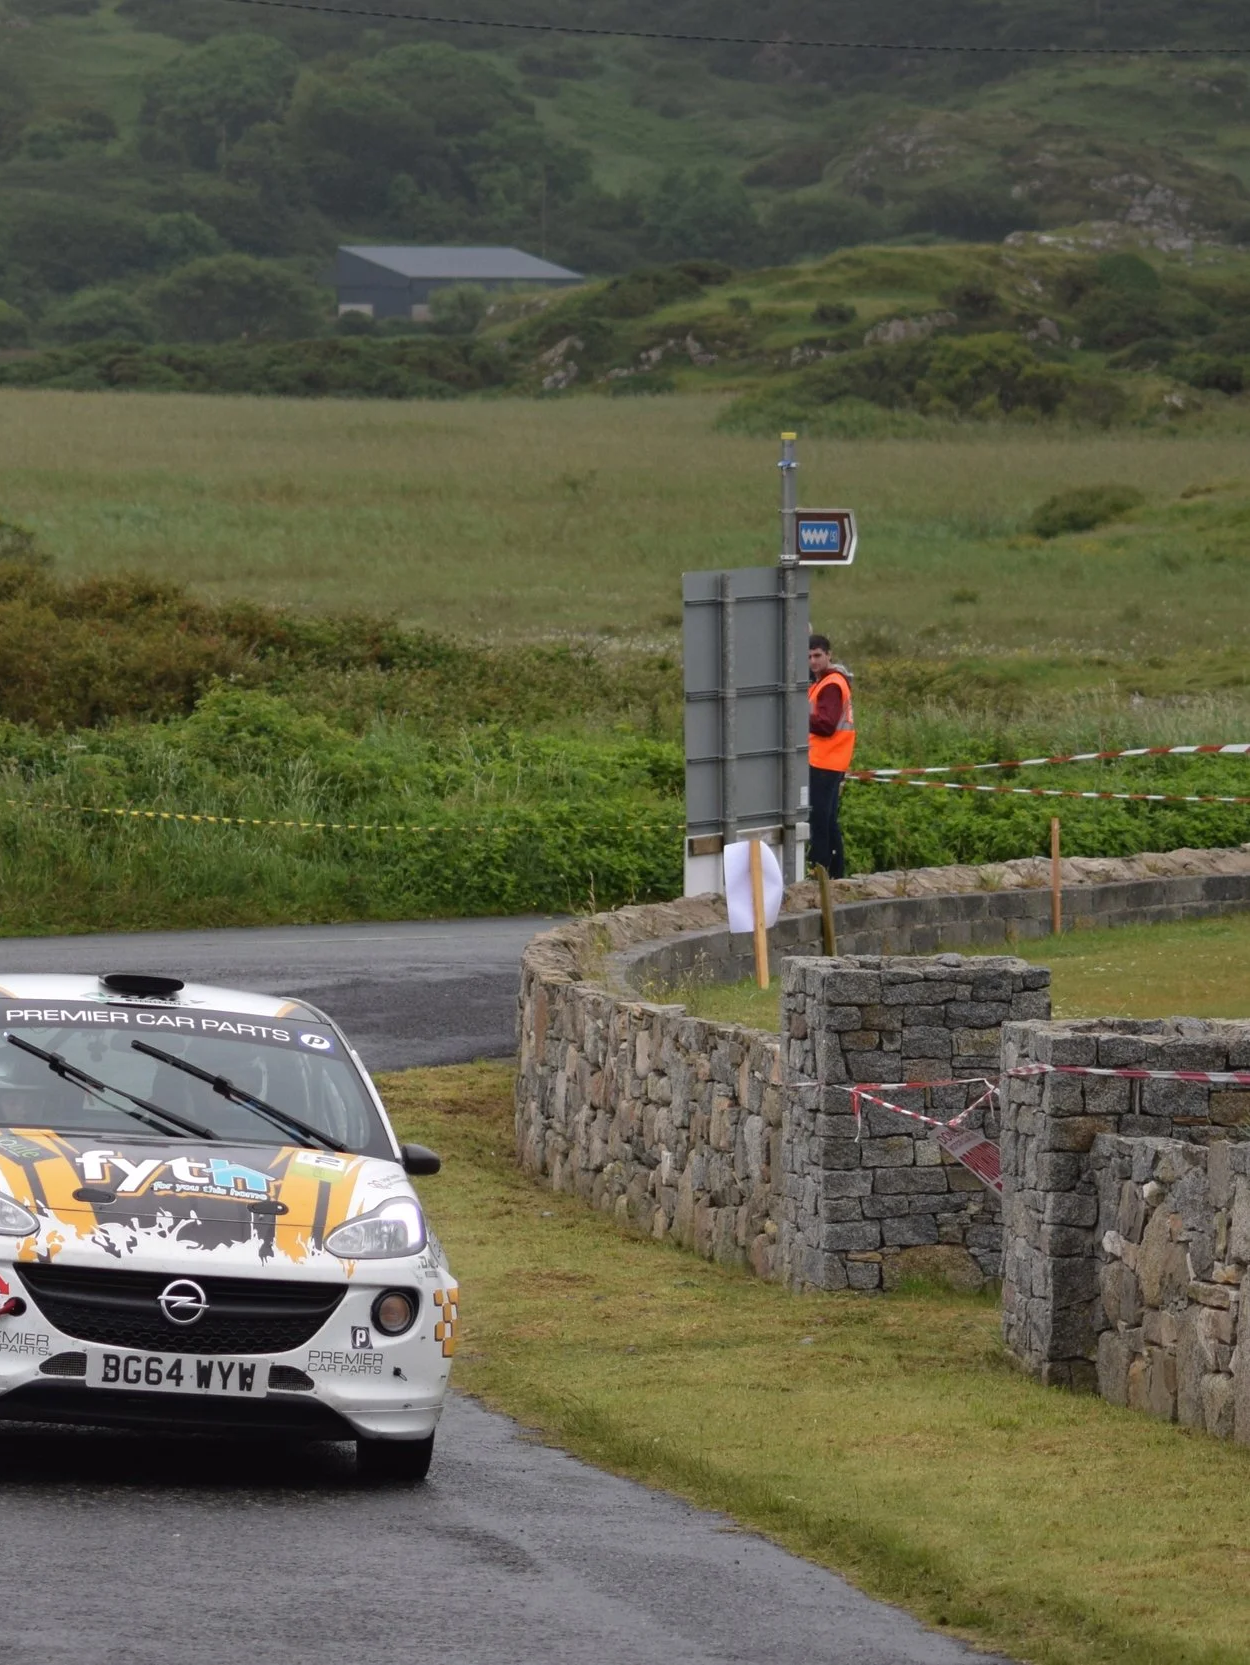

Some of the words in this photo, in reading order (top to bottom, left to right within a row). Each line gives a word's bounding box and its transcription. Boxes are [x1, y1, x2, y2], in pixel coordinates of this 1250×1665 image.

[6, 1009, 129, 1024] PREMIER
[136, 1013, 195, 1029] CAR
[201, 1018, 291, 1042] PARTS
[0, 1343, 47, 1356] PARTS
[308, 1350, 384, 1366] PREMIER
[102, 1353, 184, 1387] BG64
[196, 1359, 256, 1392] WYW
[307, 1362, 337, 1373] CAR
[340, 1364, 382, 1375] PARTS
